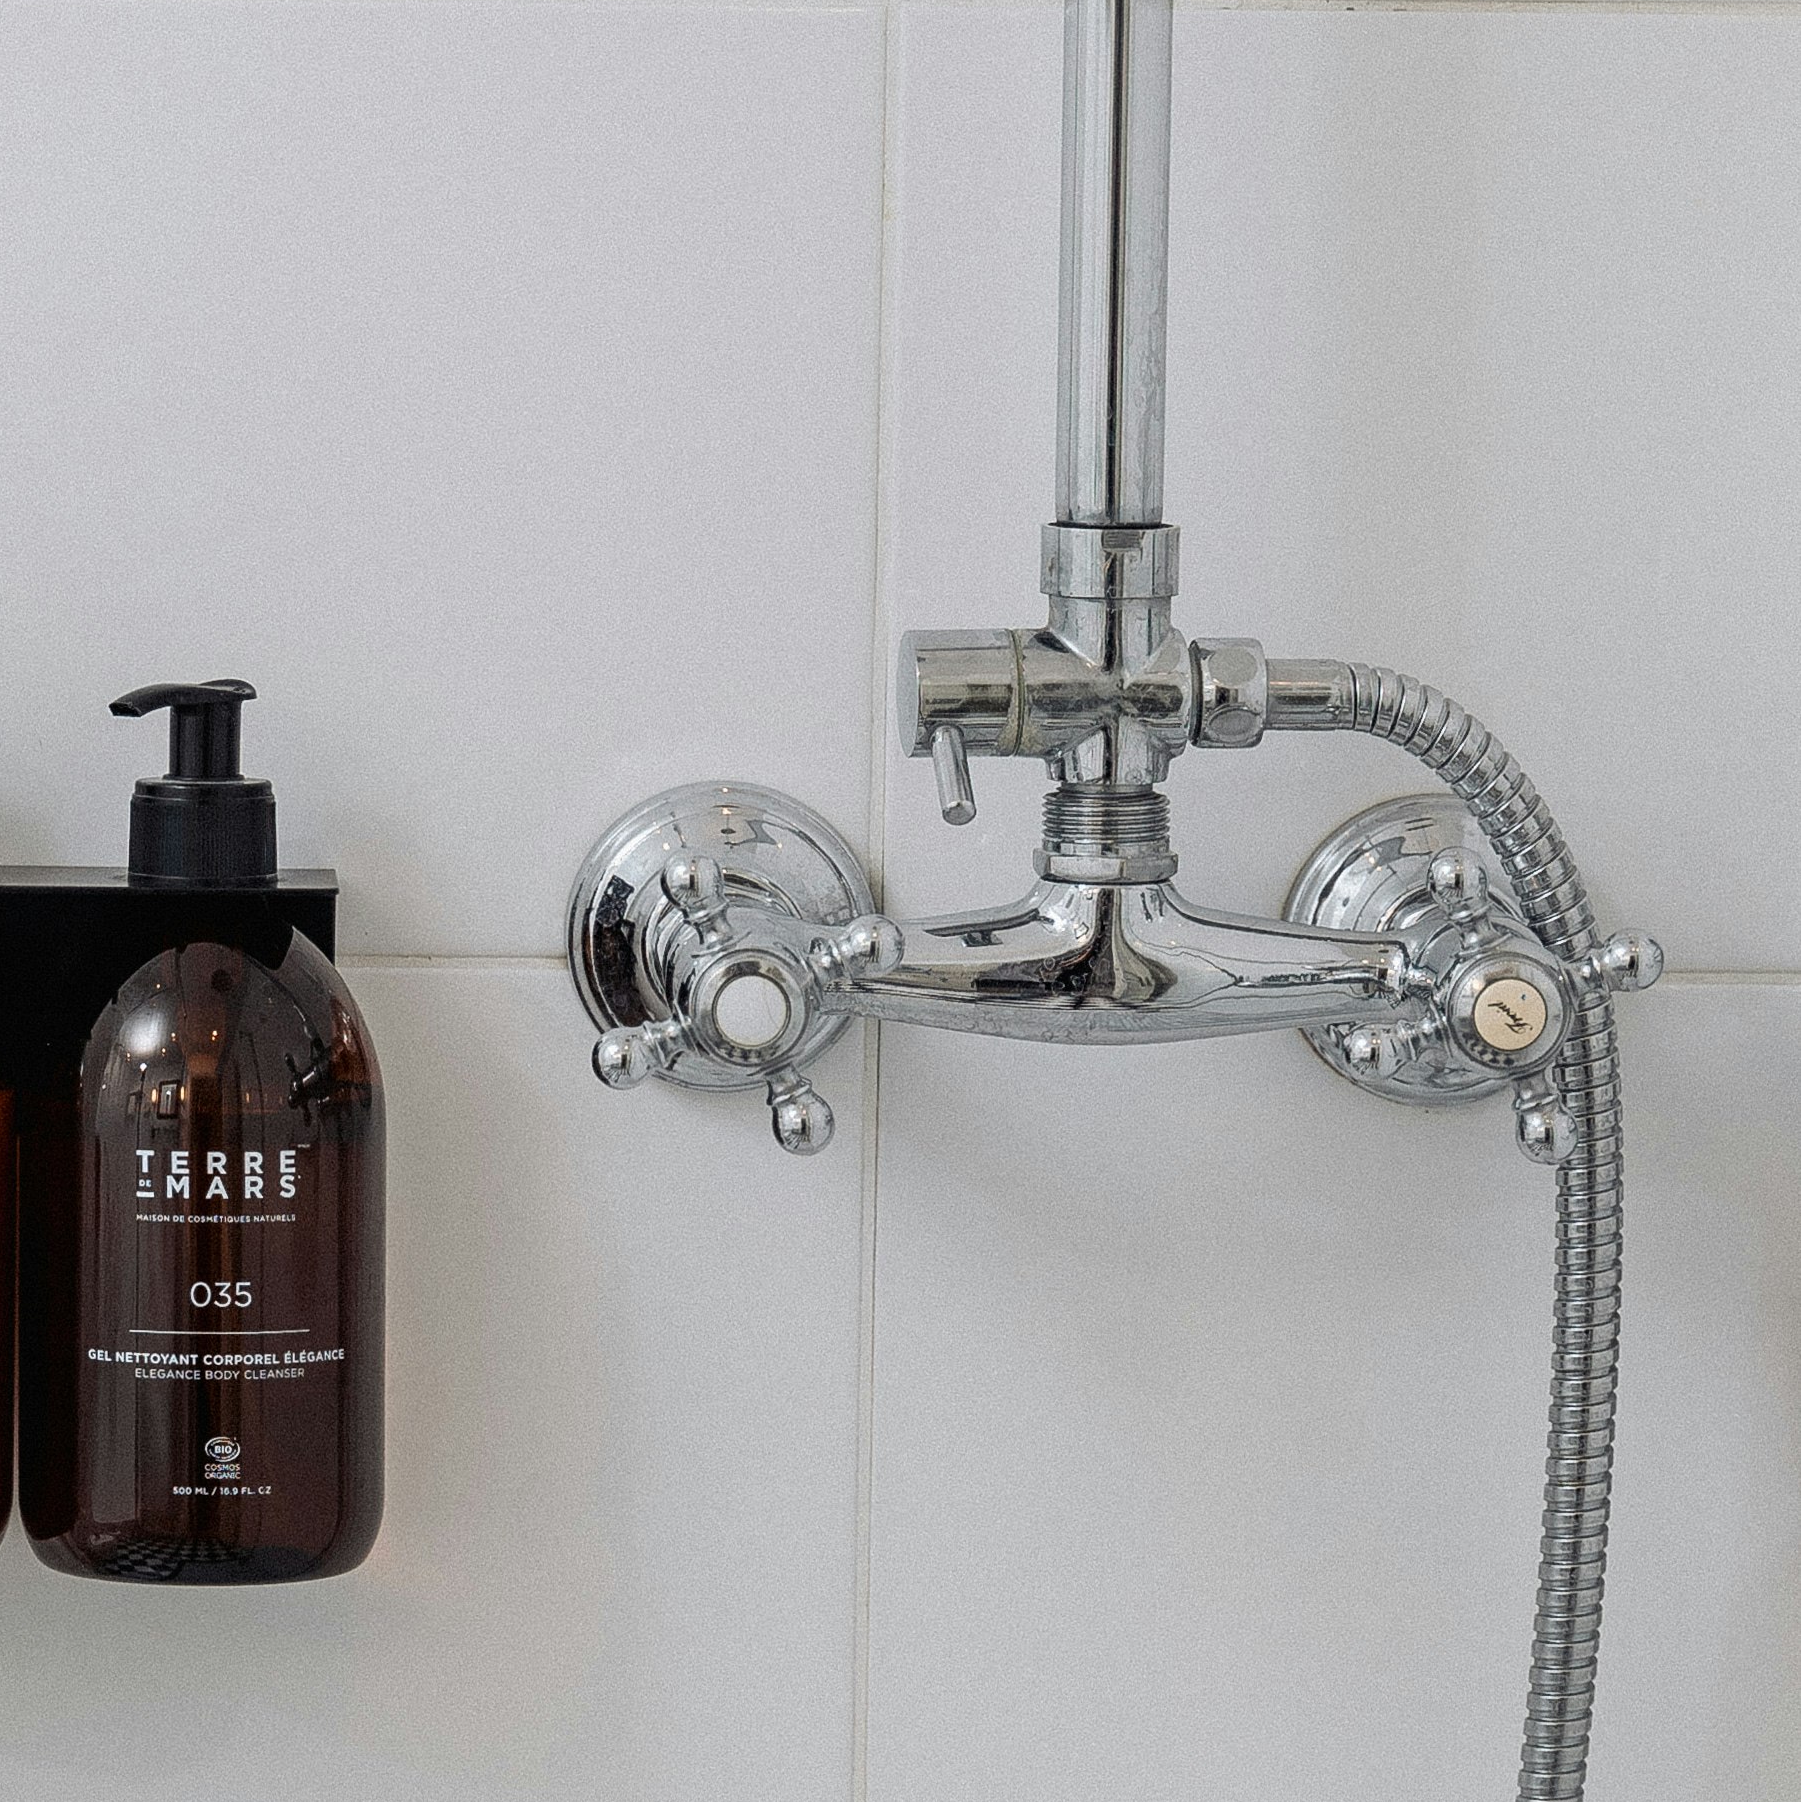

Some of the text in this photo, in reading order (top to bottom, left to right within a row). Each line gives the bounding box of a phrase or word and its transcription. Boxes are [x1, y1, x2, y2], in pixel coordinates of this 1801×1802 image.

[136, 1149, 297, 1175] TERRE
[138, 1175, 297, 1199] DE MARS
[136, 1214, 296, 1223] MAISON DE COSMÉTIQUES NATURELS
[190, 1281, 253, 1308] 035
[88, 1348, 345, 1366] GEL NETTOYANT CORPOREL ÉLÉGANCE
[134, 1367, 305, 1381] ELEGANCE BODY CLEANSER
[214, 1445, 233, 1455] BIO
[204, 1463, 241, 1472] COSMOS
[204, 1471, 241, 1479] ORGANIC
[172, 1486, 193, 1495] 500
[194, 1487, 209, 1495] ML
[219, 1487, 239, 1495] 16.9
[241, 1487, 256, 1495] FL.
